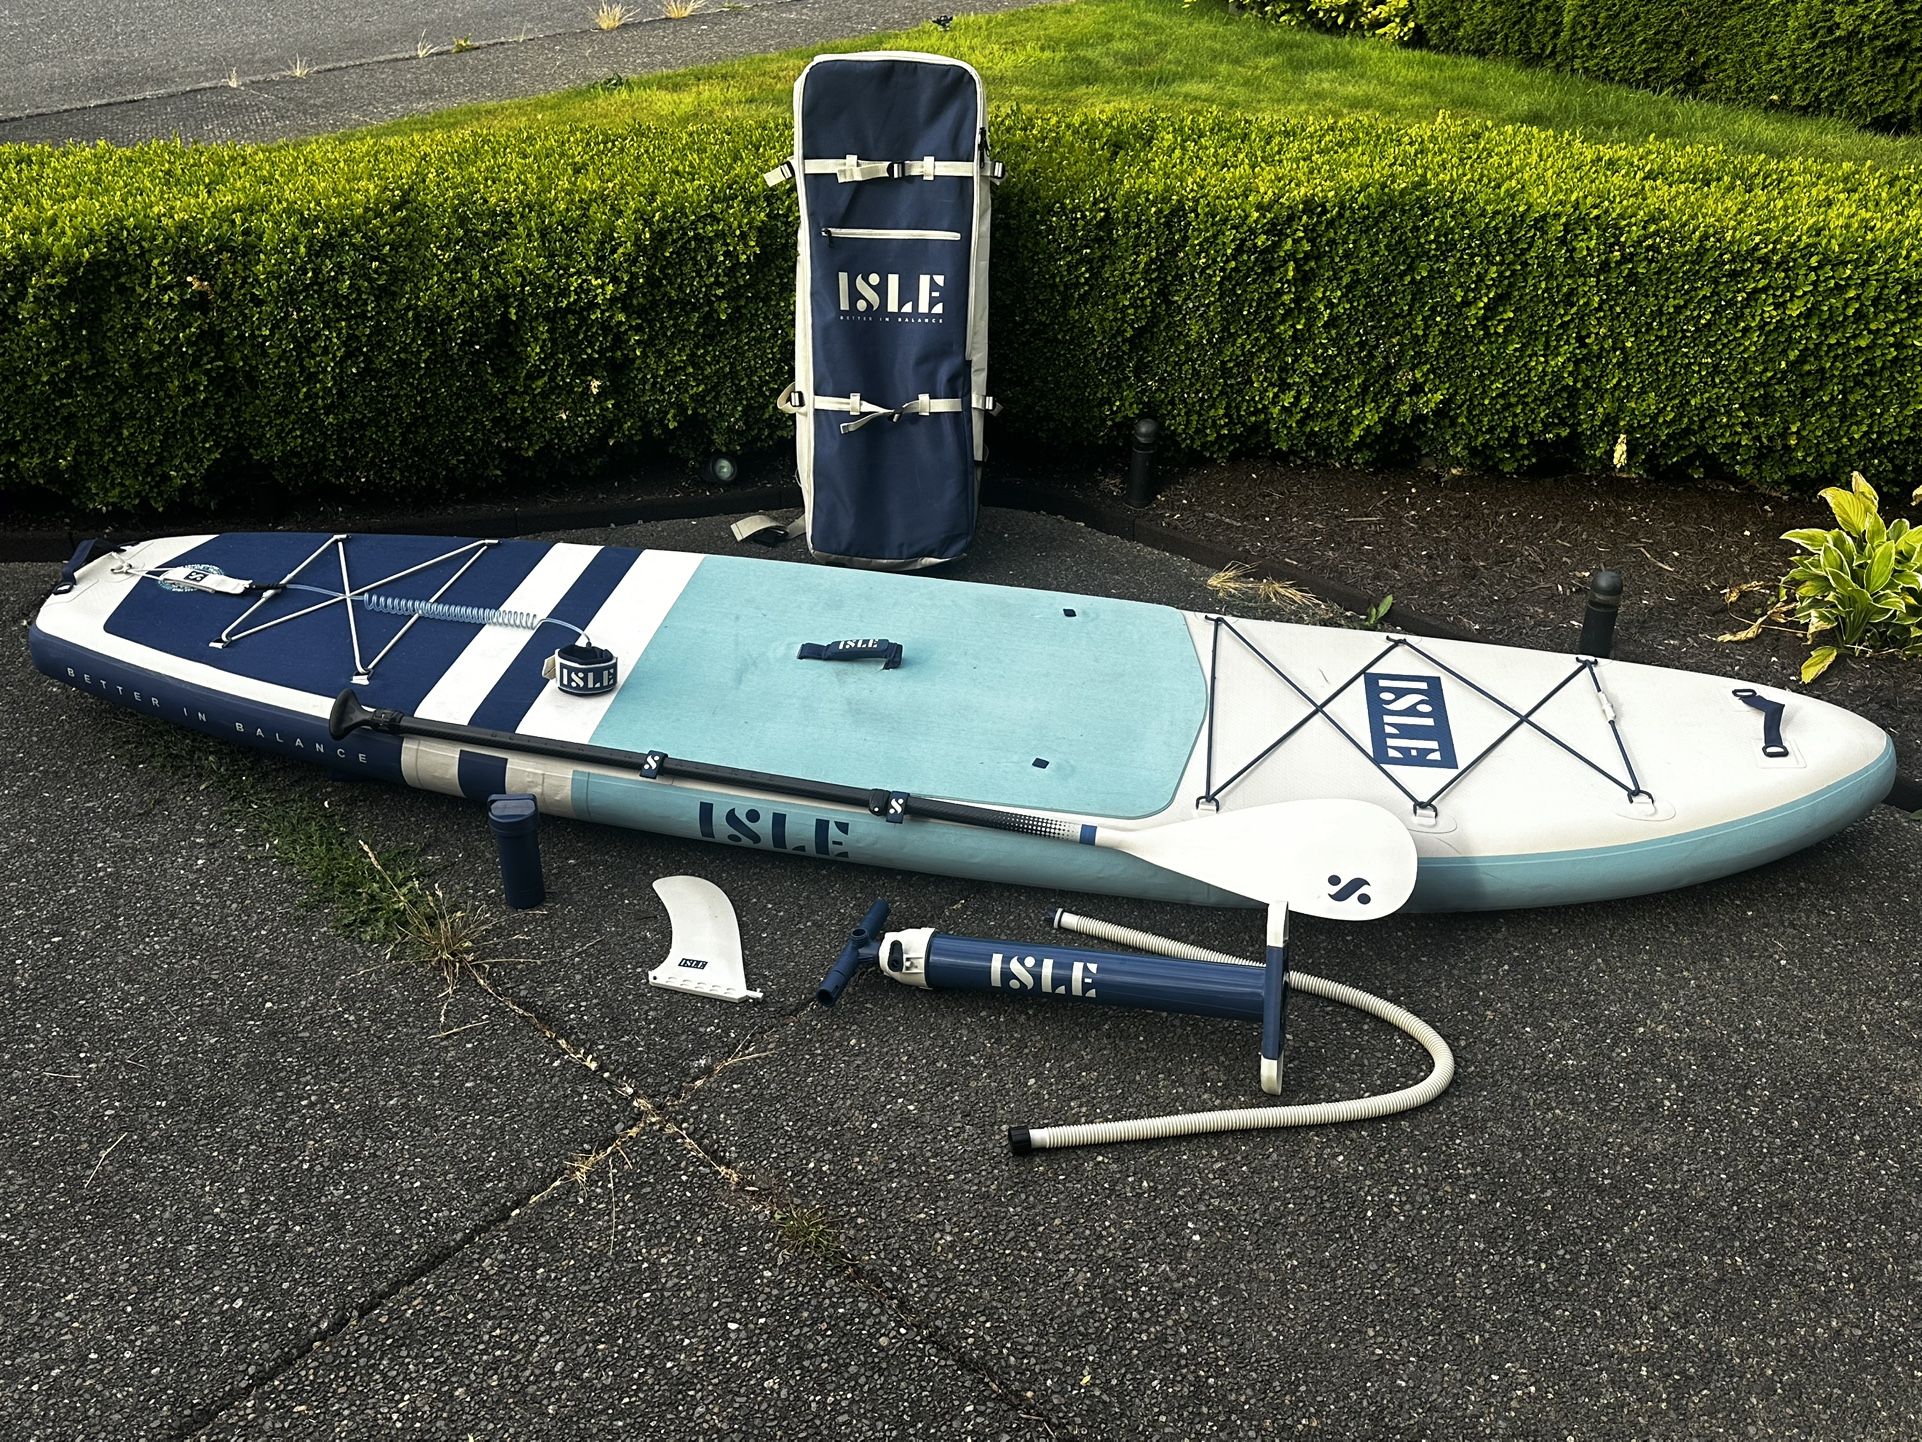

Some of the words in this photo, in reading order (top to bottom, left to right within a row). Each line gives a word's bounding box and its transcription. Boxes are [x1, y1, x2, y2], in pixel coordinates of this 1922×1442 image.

[838, 271, 945, 314] ISLE
[838, 639, 880, 650] ISLE
[562, 668, 615, 688] ISLE
[66, 667, 160, 708] BETTER
[183, 707, 207, 722] IN
[235, 722, 368, 763] BALANCE
[1377, 679, 1442, 761] ISLE
[699, 801, 850, 859] ISLE
[680, 959, 706, 969] ISLE
[990, 953, 1099, 998] ISLE
